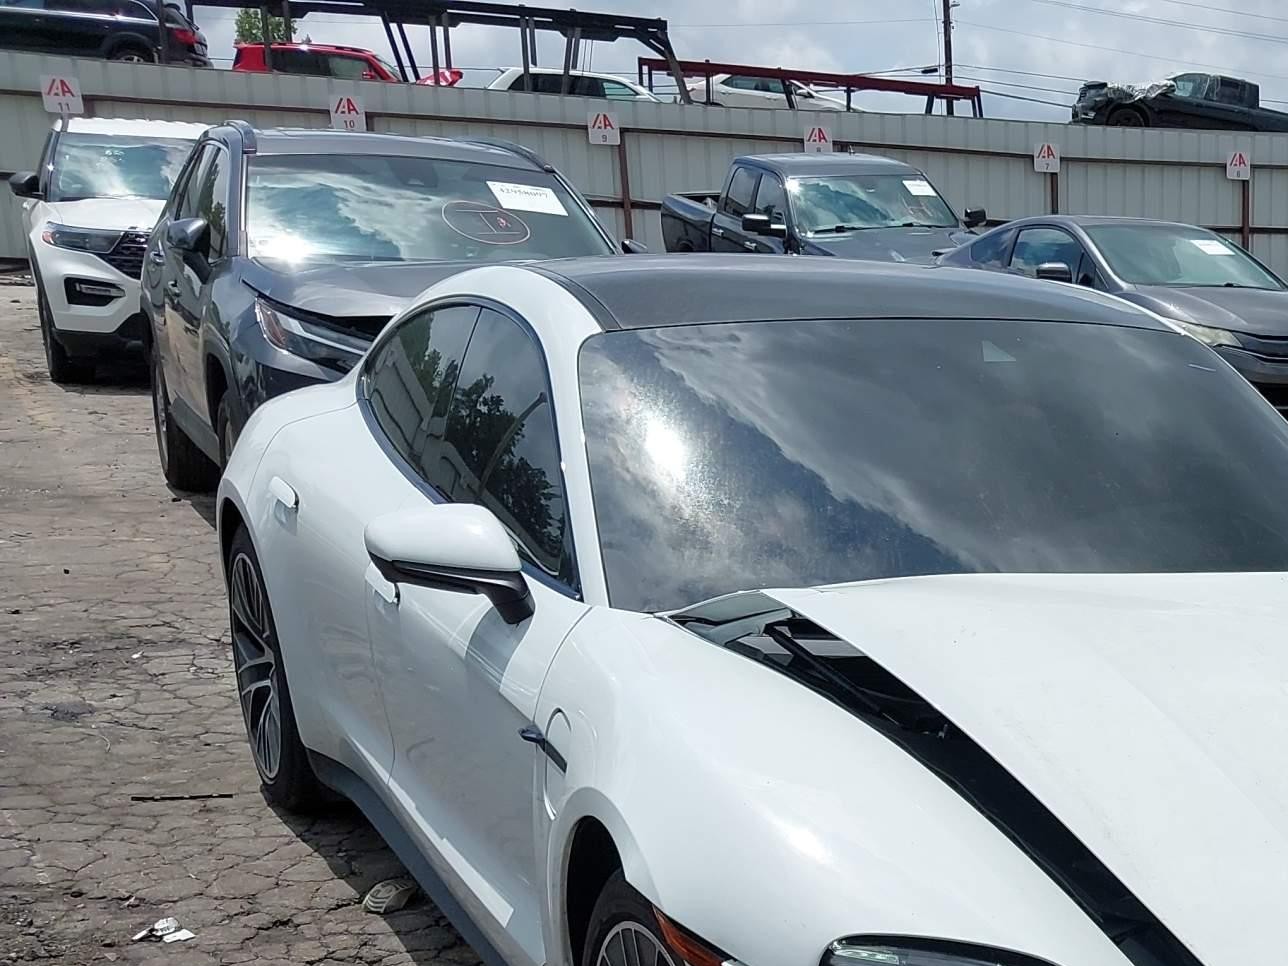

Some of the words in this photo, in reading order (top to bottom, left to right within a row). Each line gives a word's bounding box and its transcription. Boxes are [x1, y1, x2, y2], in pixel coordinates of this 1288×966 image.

[344, 119, 355, 129] 10
[601, 134, 608, 143] 9
[1045, 162, 1051, 171] 7
